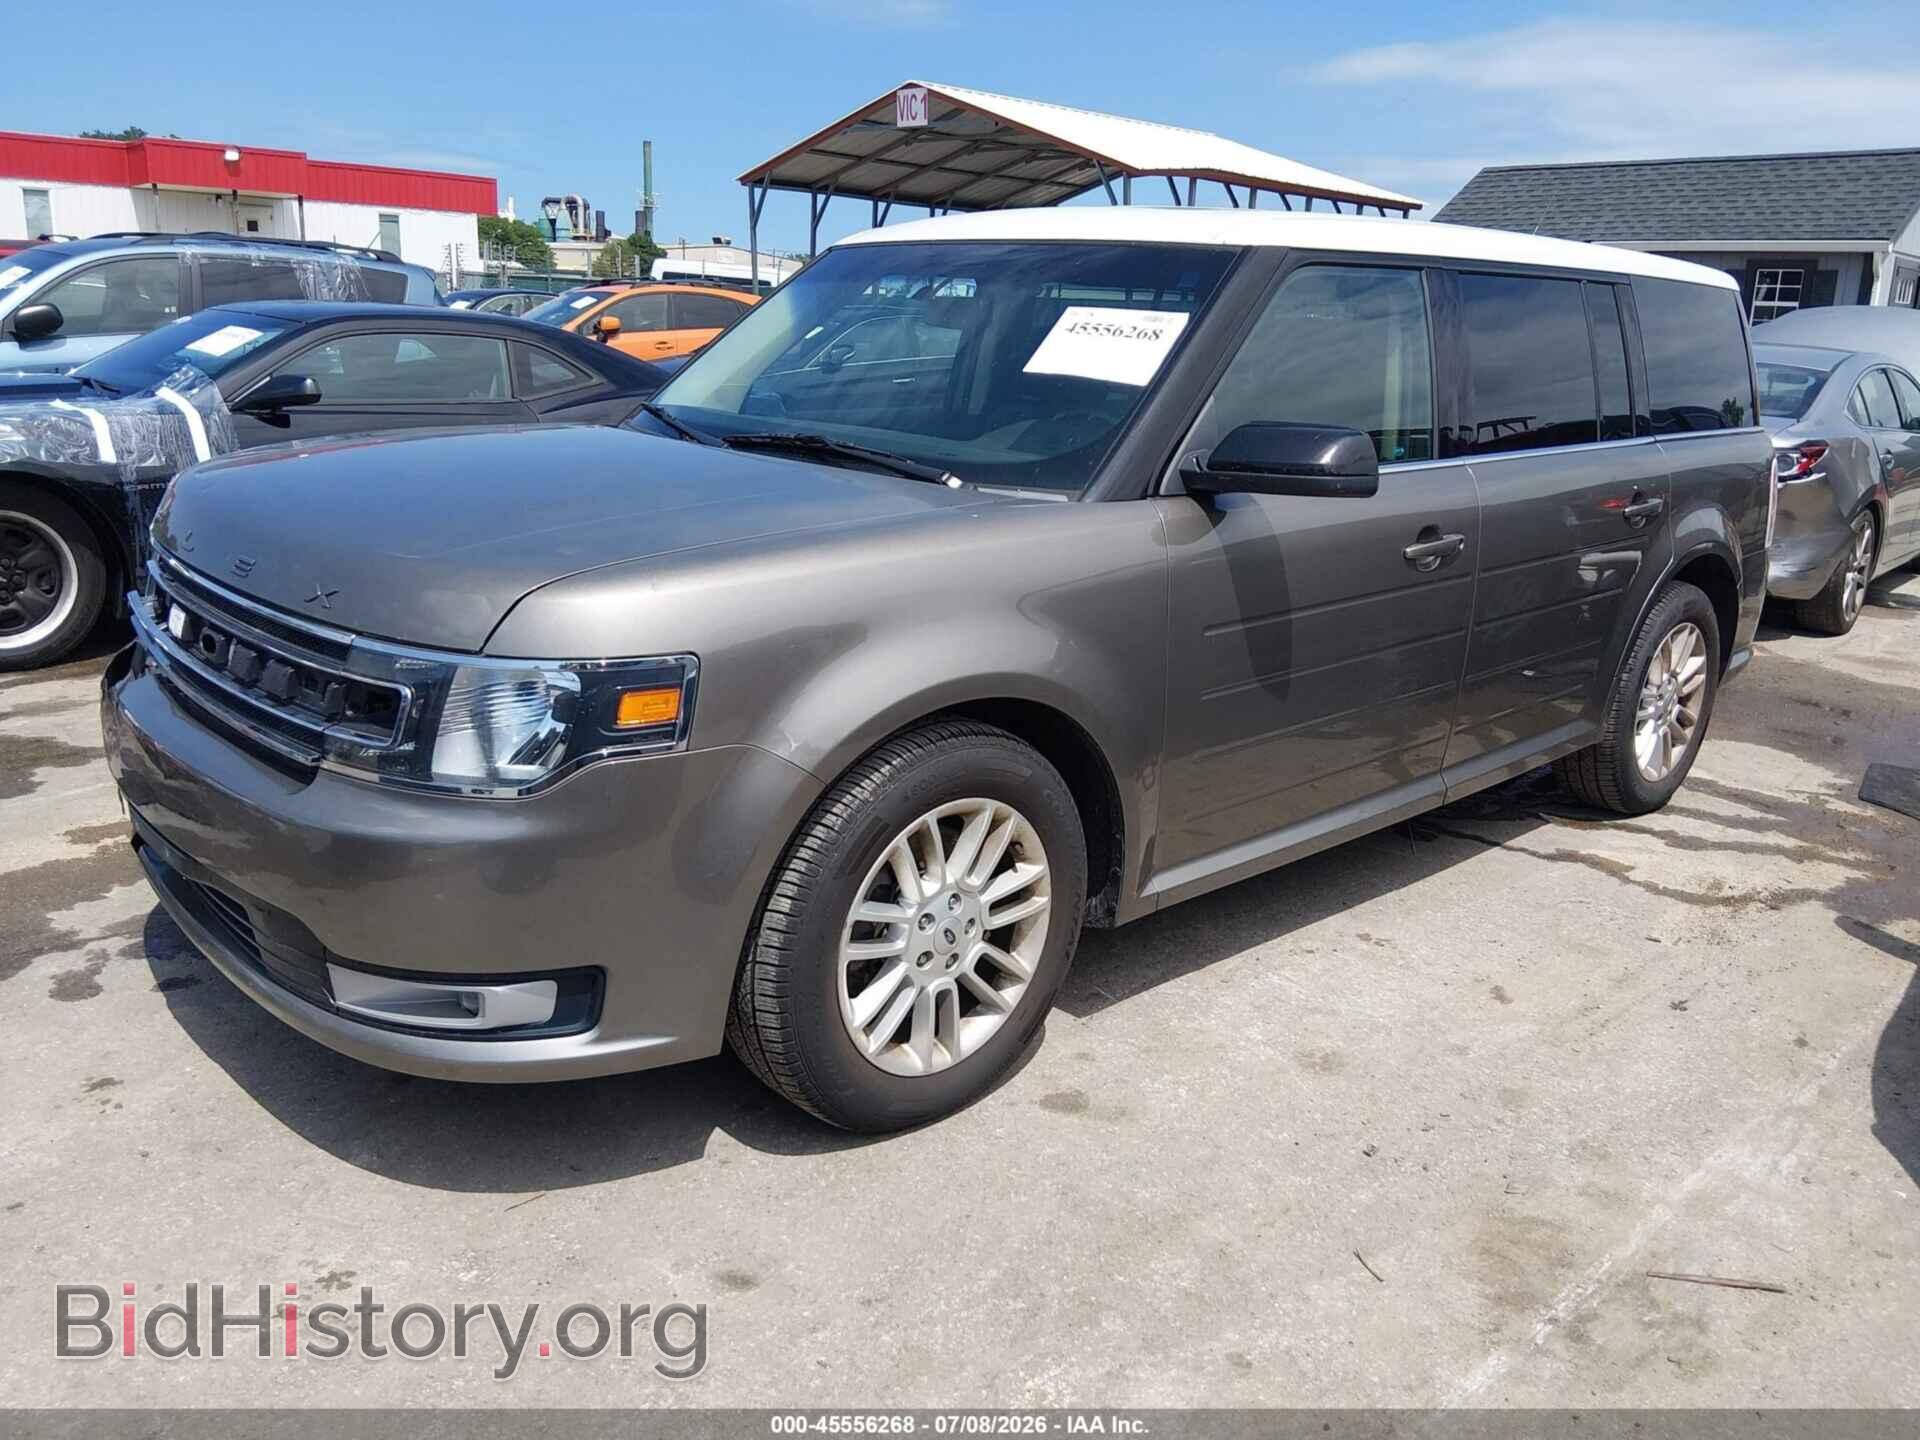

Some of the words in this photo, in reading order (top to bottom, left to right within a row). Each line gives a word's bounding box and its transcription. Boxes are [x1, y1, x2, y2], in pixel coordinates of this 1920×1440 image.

[897, 94, 918, 121] VIC
[920, 94, 927, 120] 1
[1065, 322, 1164, 341] 45556268
